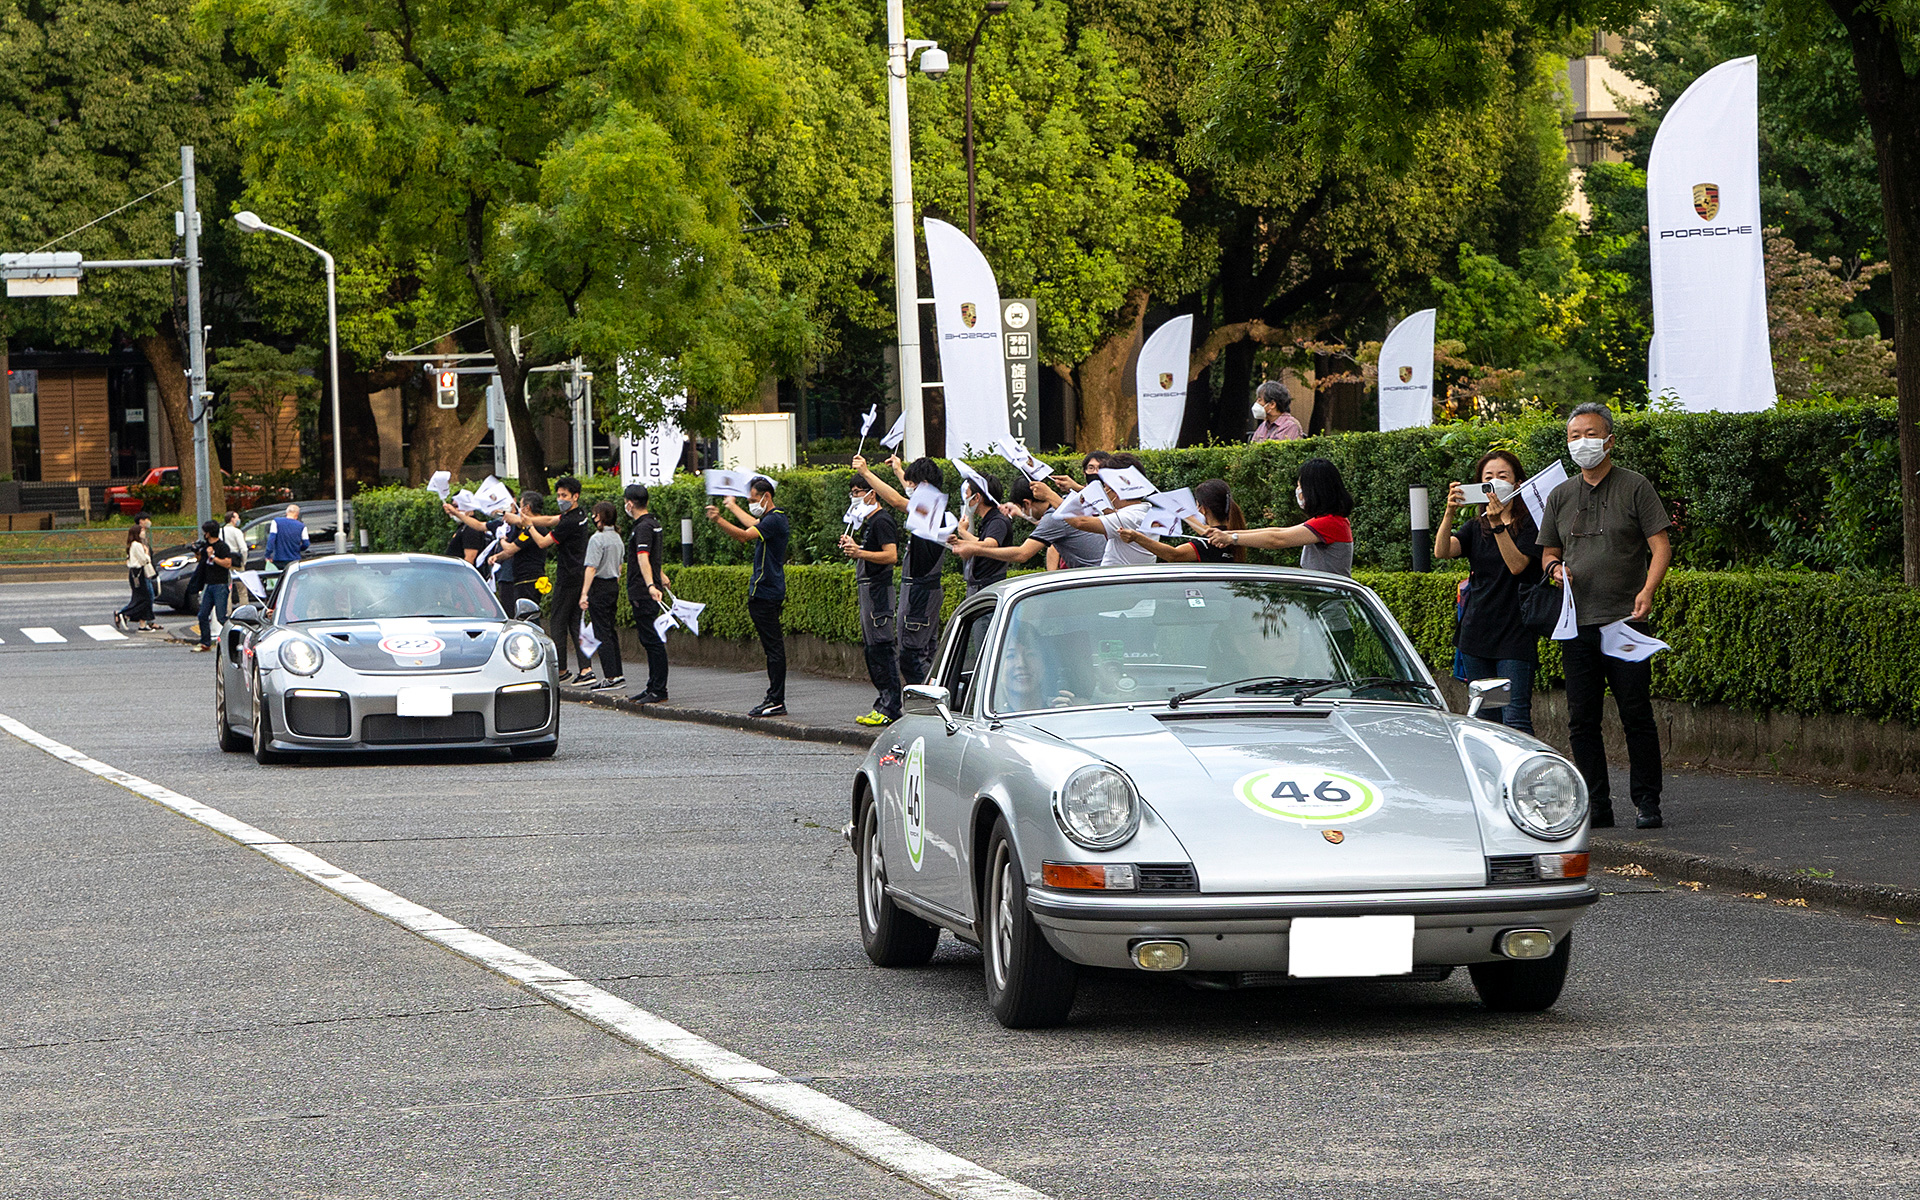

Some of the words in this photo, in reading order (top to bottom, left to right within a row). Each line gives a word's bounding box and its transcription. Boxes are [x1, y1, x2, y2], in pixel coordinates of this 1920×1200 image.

[1660, 225, 1753, 240] PORSCHE
[650, 423, 661, 477] CLASS
[395, 640, 430, 649] 22
[907, 774, 920, 828] 46
[1270, 780, 1351, 803] 46
